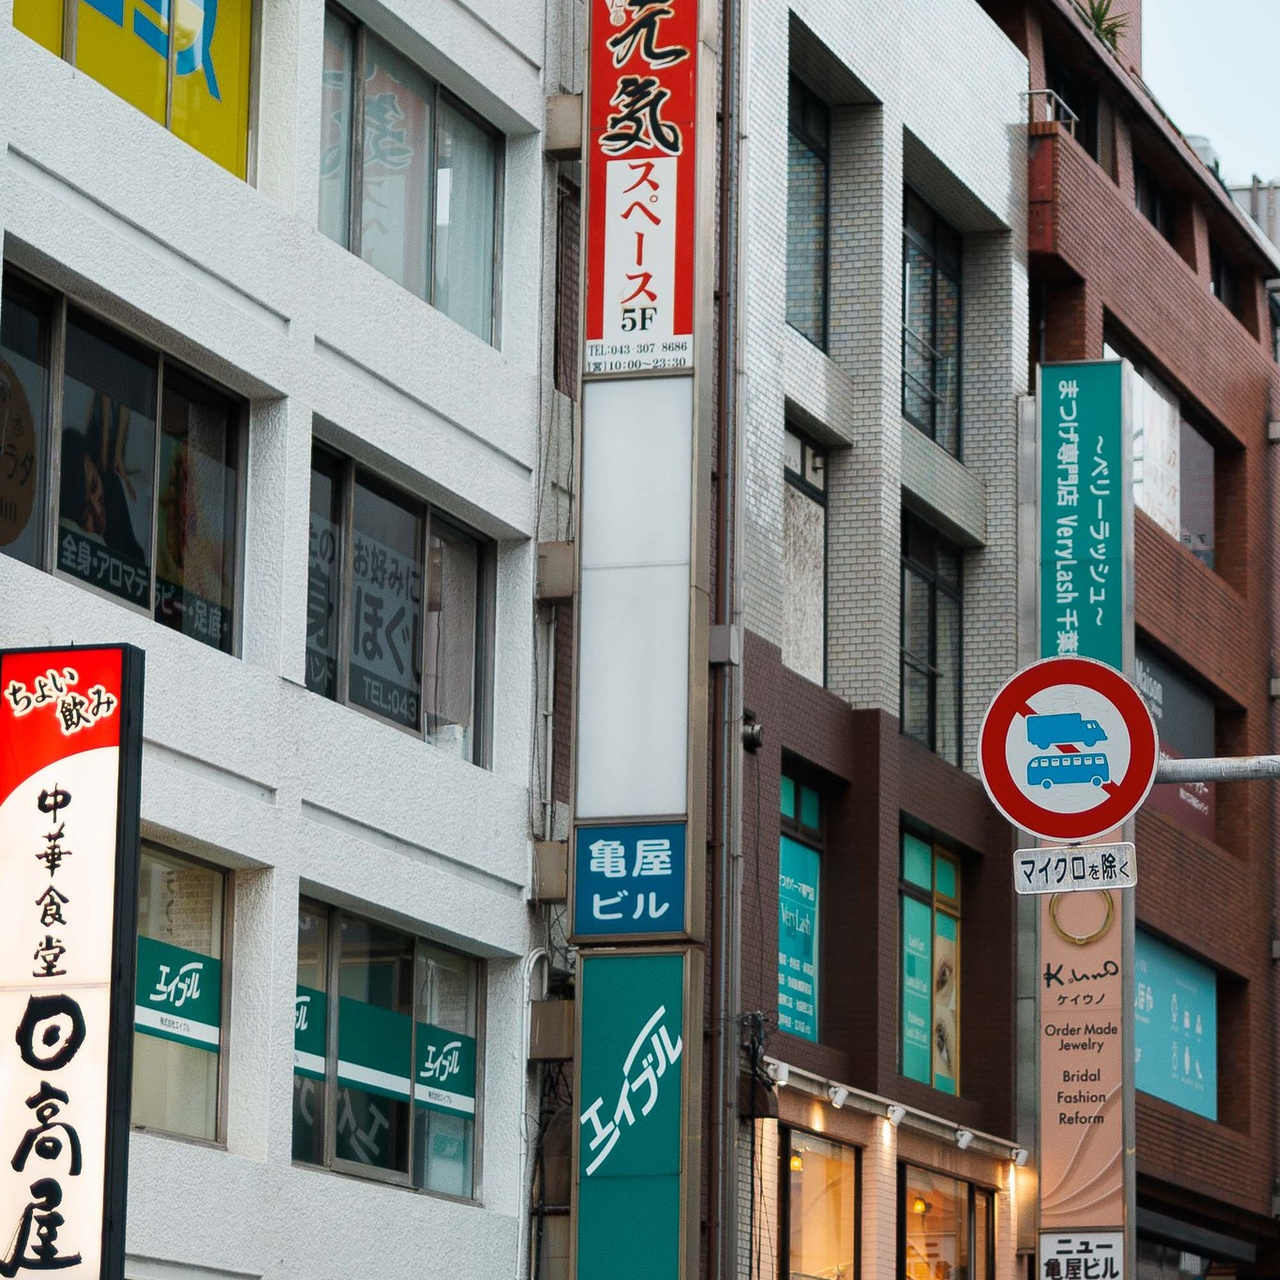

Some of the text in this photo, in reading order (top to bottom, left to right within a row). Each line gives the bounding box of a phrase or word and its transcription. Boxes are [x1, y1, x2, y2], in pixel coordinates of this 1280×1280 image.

[619, 161, 662, 304] スペース
[621, 305, 658, 332] 5F
[1055, 377, 1080, 508] まつげ専門店
[1055, 514, 1079, 605] VeryLash
[4, 666, 79, 718] ちょい
[56, 684, 117, 736] 飲み
[588, 838, 674, 879] 亀屋
[1020, 853, 1132, 888] マイクロを除く
[592, 890, 670, 921] ビル
[149, 962, 204, 1007] エイブル
[1057, 992, 1106, 1007] ケイウノ
[1, 782, 85, 1280] 中華食堂 日高屋
[1044, 1022, 1118, 1037] Order Made
[1058, 1038, 1105, 1055] Jewelry
[419, 1040, 462, 1082] エイブル
[1062, 1070, 1101, 1083] Bridal
[579, 1004, 683, 1178] エイブル
[1057, 1091, 1107, 1104] Fashion
[1058, 1112, 1105, 1125] Reform
[1055, 1238, 1114, 1256] ニュー
[1043, 1257, 1120, 1280] 亀屋ビル
